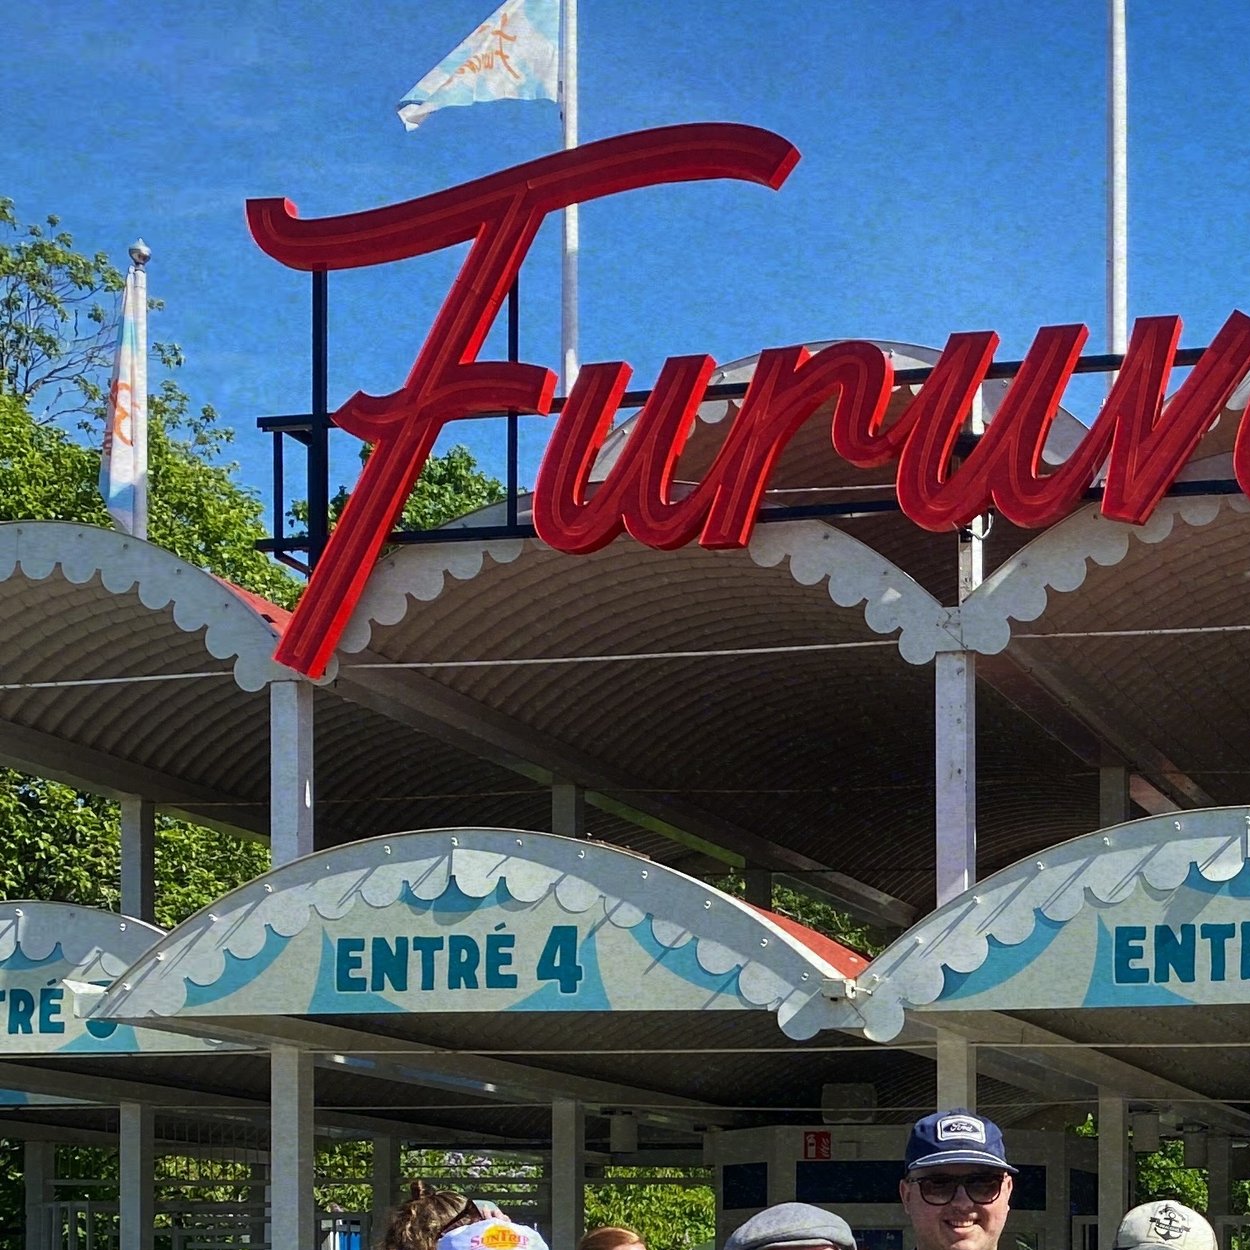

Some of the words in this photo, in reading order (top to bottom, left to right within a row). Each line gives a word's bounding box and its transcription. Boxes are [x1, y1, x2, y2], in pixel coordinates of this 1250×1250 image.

[336, 922, 518, 992] ENTRÉ
[536, 925, 583, 993] 4
[949, 1122, 973, 1132] Ford
